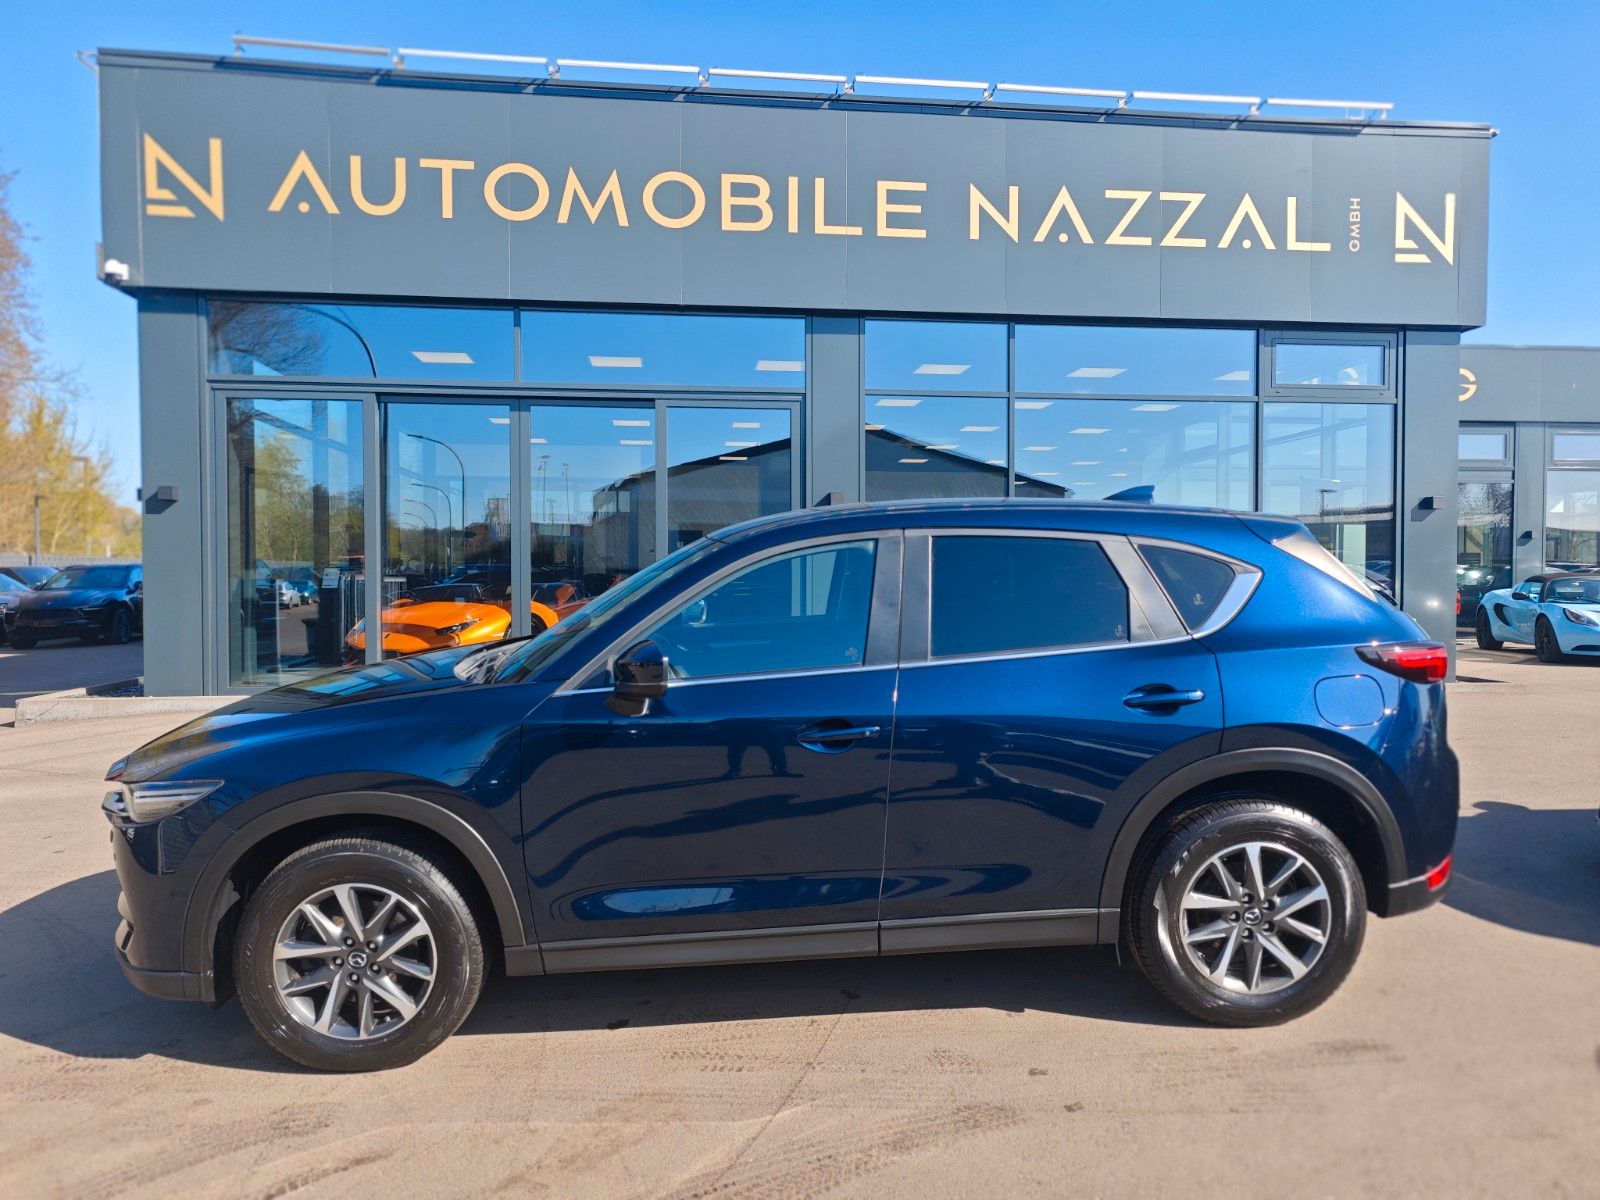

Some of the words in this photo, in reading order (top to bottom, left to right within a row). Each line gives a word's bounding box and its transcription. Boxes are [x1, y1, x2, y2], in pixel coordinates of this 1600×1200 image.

[268, 151, 928, 240] AUTOMOBILE
[968, 184, 1332, 252] NAZZAL
[1349, 197, 1361, 252] GMBH
